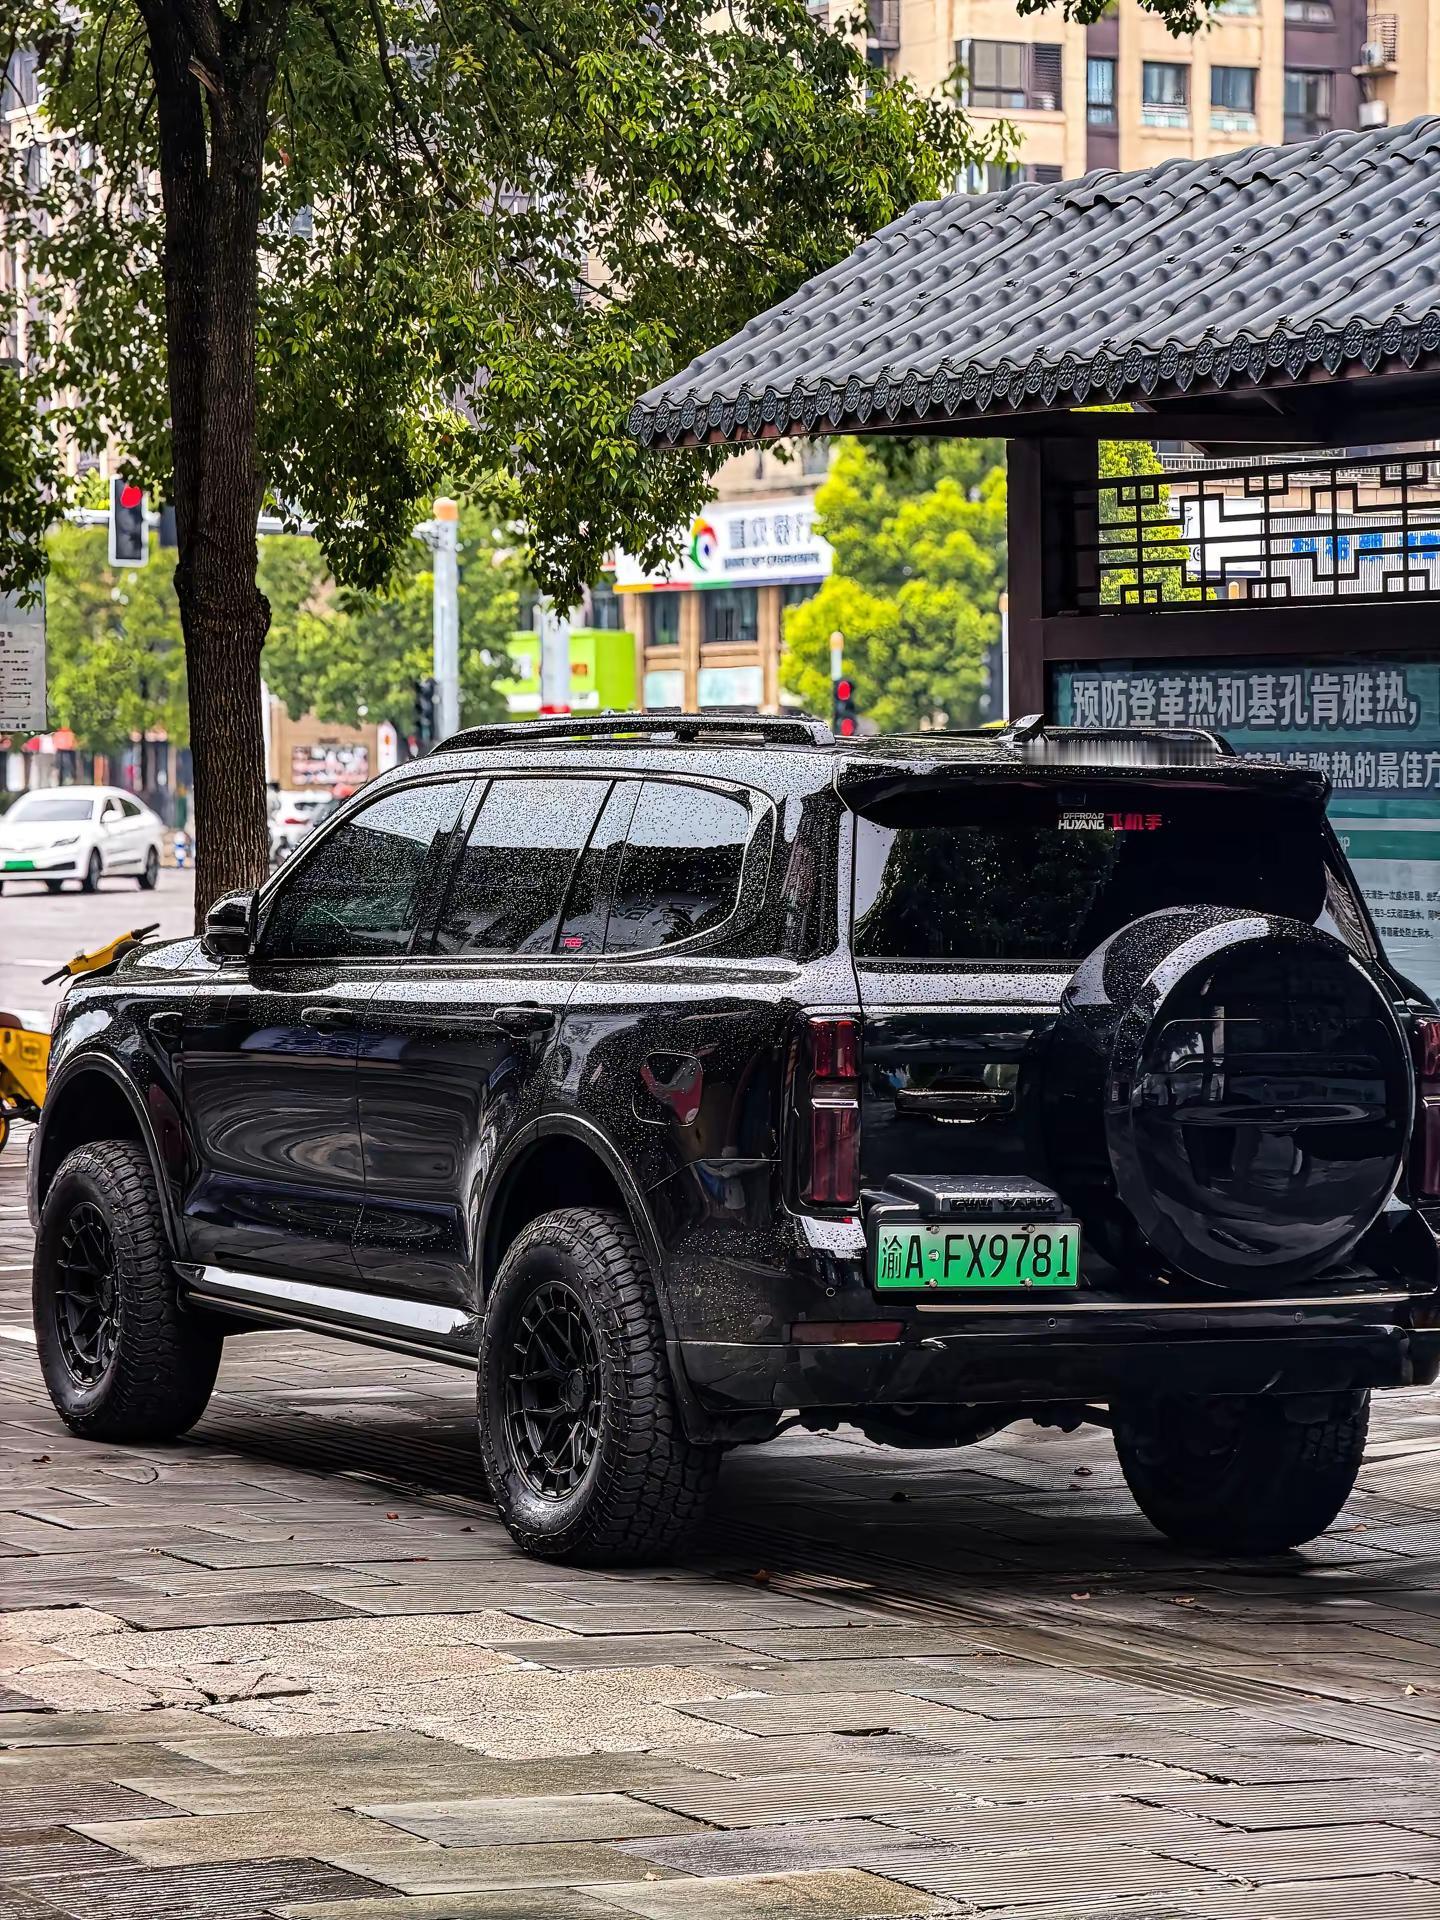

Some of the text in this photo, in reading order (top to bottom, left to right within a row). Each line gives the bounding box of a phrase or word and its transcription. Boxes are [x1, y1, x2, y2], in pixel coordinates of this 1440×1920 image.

[1073, 671, 1417, 727] 预防登革热和基孔肯雅热，
[1063, 812, 1105, 820] OFFROAD
[1105, 813, 1162, 831] 飞机手
[1057, 819, 1105, 830] HUYANG
